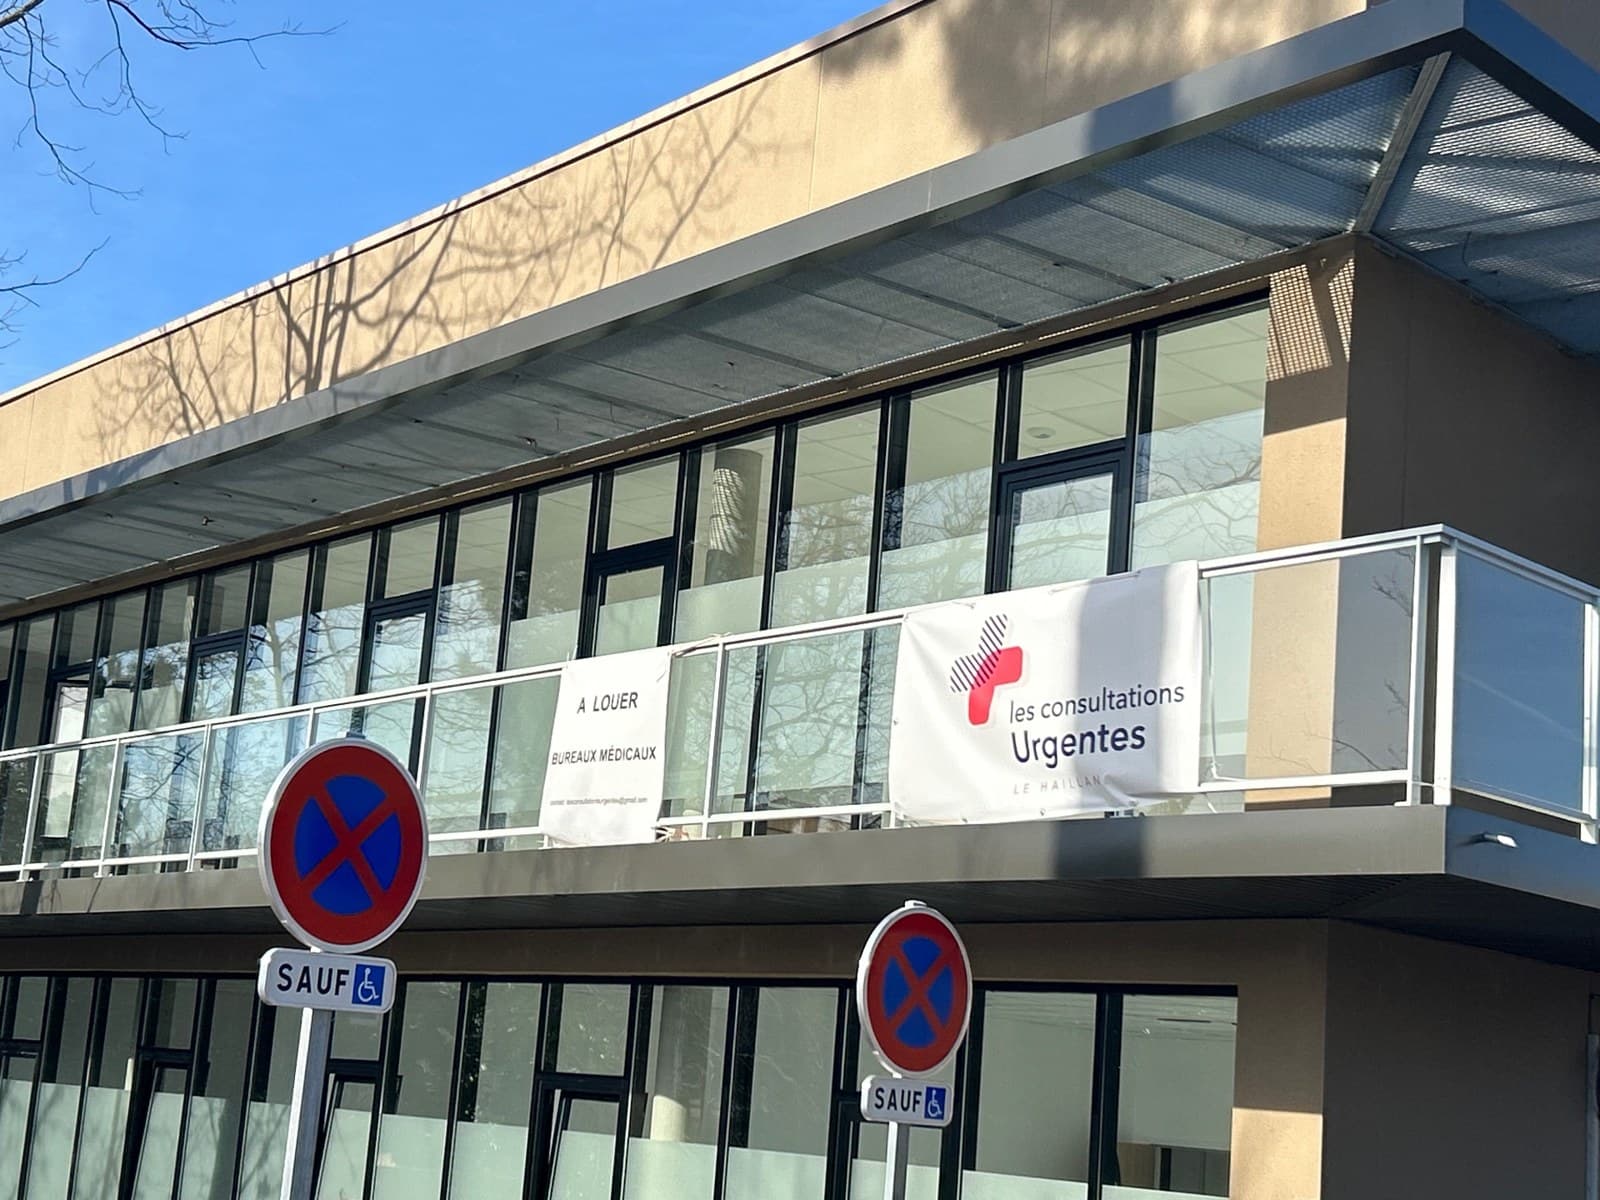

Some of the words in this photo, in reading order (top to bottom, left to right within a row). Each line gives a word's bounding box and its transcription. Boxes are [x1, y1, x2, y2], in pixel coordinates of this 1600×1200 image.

[577, 697, 586, 714] A
[593, 691, 638, 712] LOUER
[1010, 700, 1034, 723] les
[1041, 684, 1184, 719] consultations
[552, 749, 597, 765] BUREAUX
[599, 745, 656, 762] MÉDICAUX
[1011, 724, 1146, 768] Urgentes
[1013, 784, 1030, 795] LE
[277, 963, 349, 996] SAUF
[874, 1087, 922, 1112] SAUF
